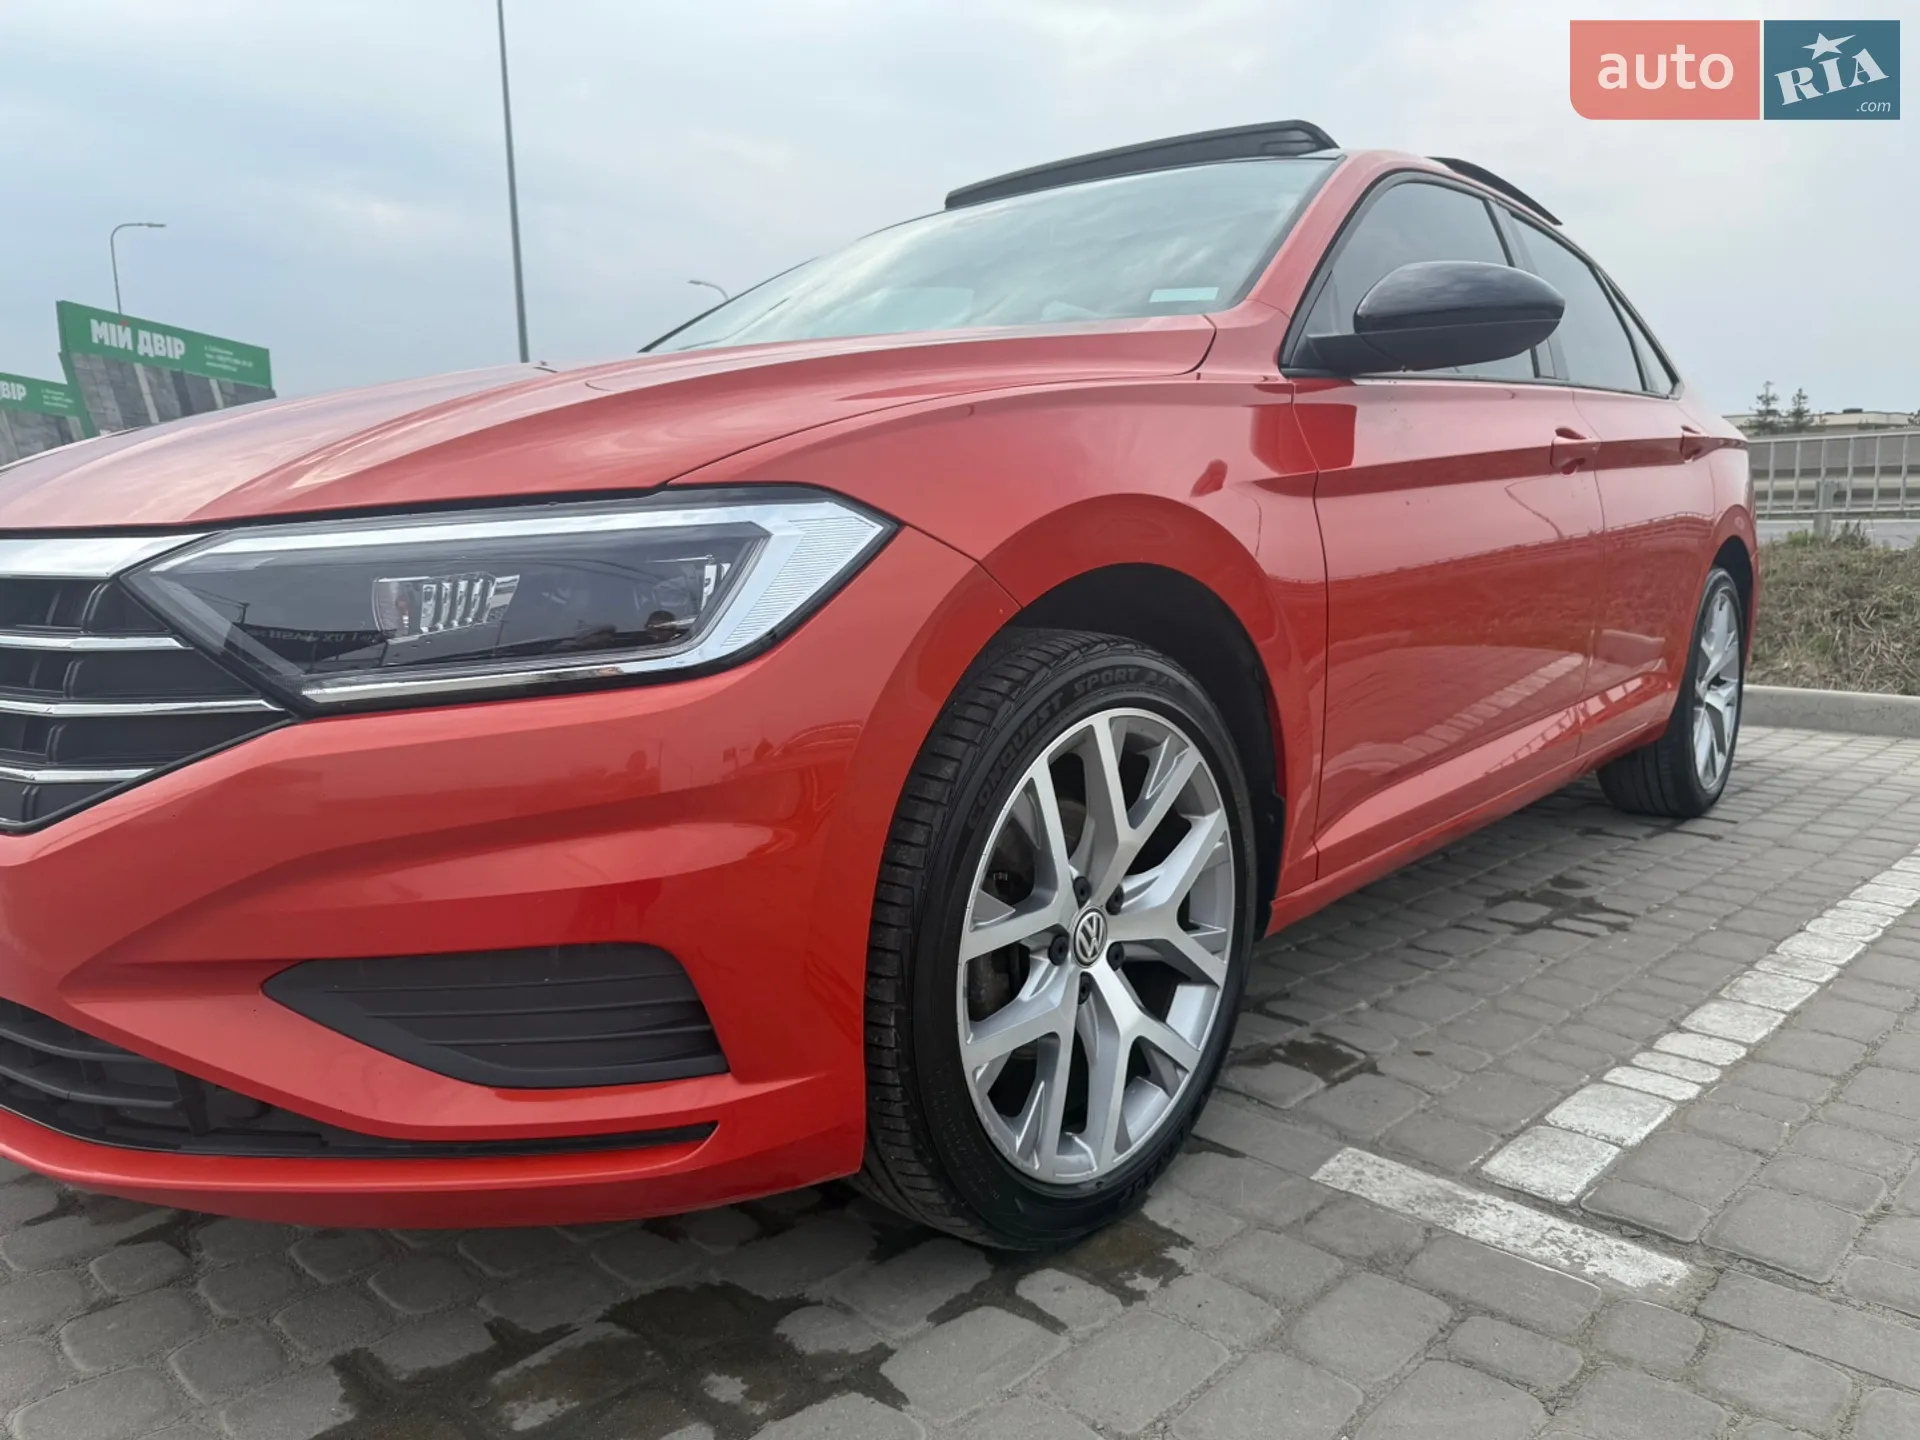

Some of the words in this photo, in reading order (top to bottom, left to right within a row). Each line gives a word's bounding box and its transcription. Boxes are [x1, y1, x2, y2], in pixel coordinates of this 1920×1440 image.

[90, 319, 133, 351] МІЙ
[137, 329, 185, 360] ДВІР
[967, 691, 1063, 830] CONQUEST
[1074, 668, 1139, 697] SPORT
